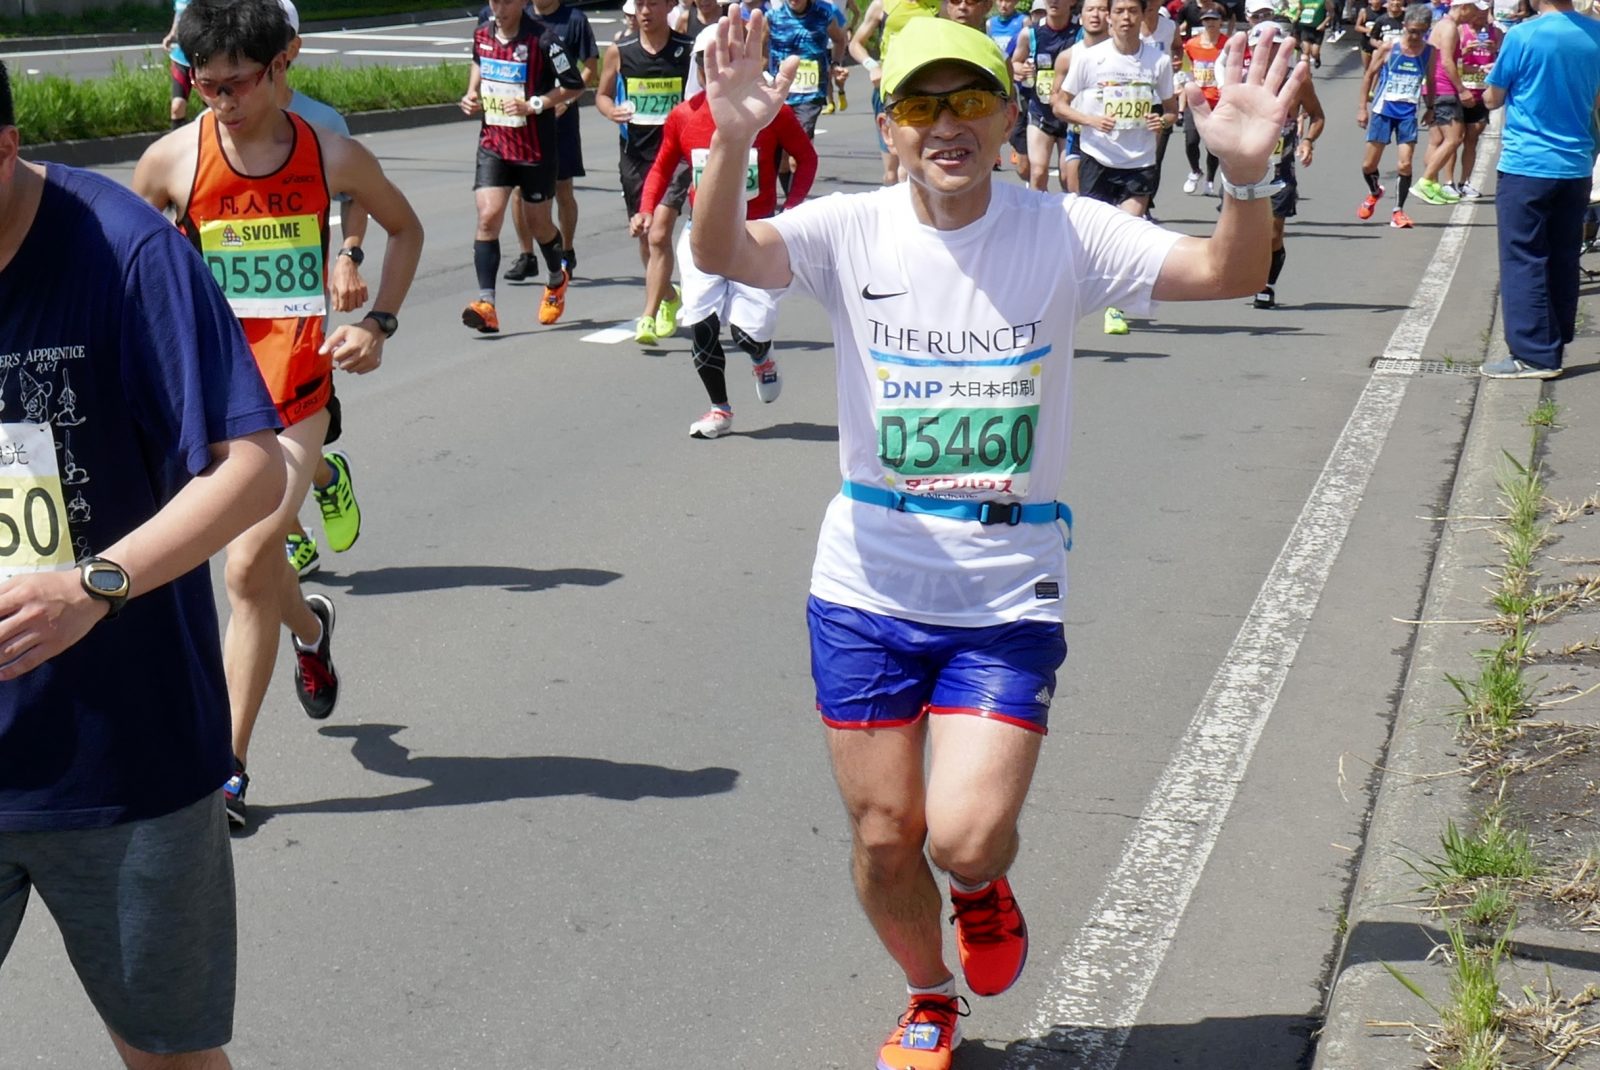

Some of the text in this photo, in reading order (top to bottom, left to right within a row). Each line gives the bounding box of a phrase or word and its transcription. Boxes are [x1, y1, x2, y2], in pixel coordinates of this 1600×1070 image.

[646, 81, 673, 89] SVOLME
[1104, 101, 1151, 119] C4280
[241, 221, 301, 242] SVOLME
[206, 251, 320, 294] D5588
[283, 302, 313, 313] NEC
[867, 318, 1042, 355] THE RUNCET
[23, 345, 86, 367] APPRENTICE
[882, 380, 943, 399] DNP
[948, 378, 1036, 399] 大日本印刷
[880, 413, 1035, 469] D5460
